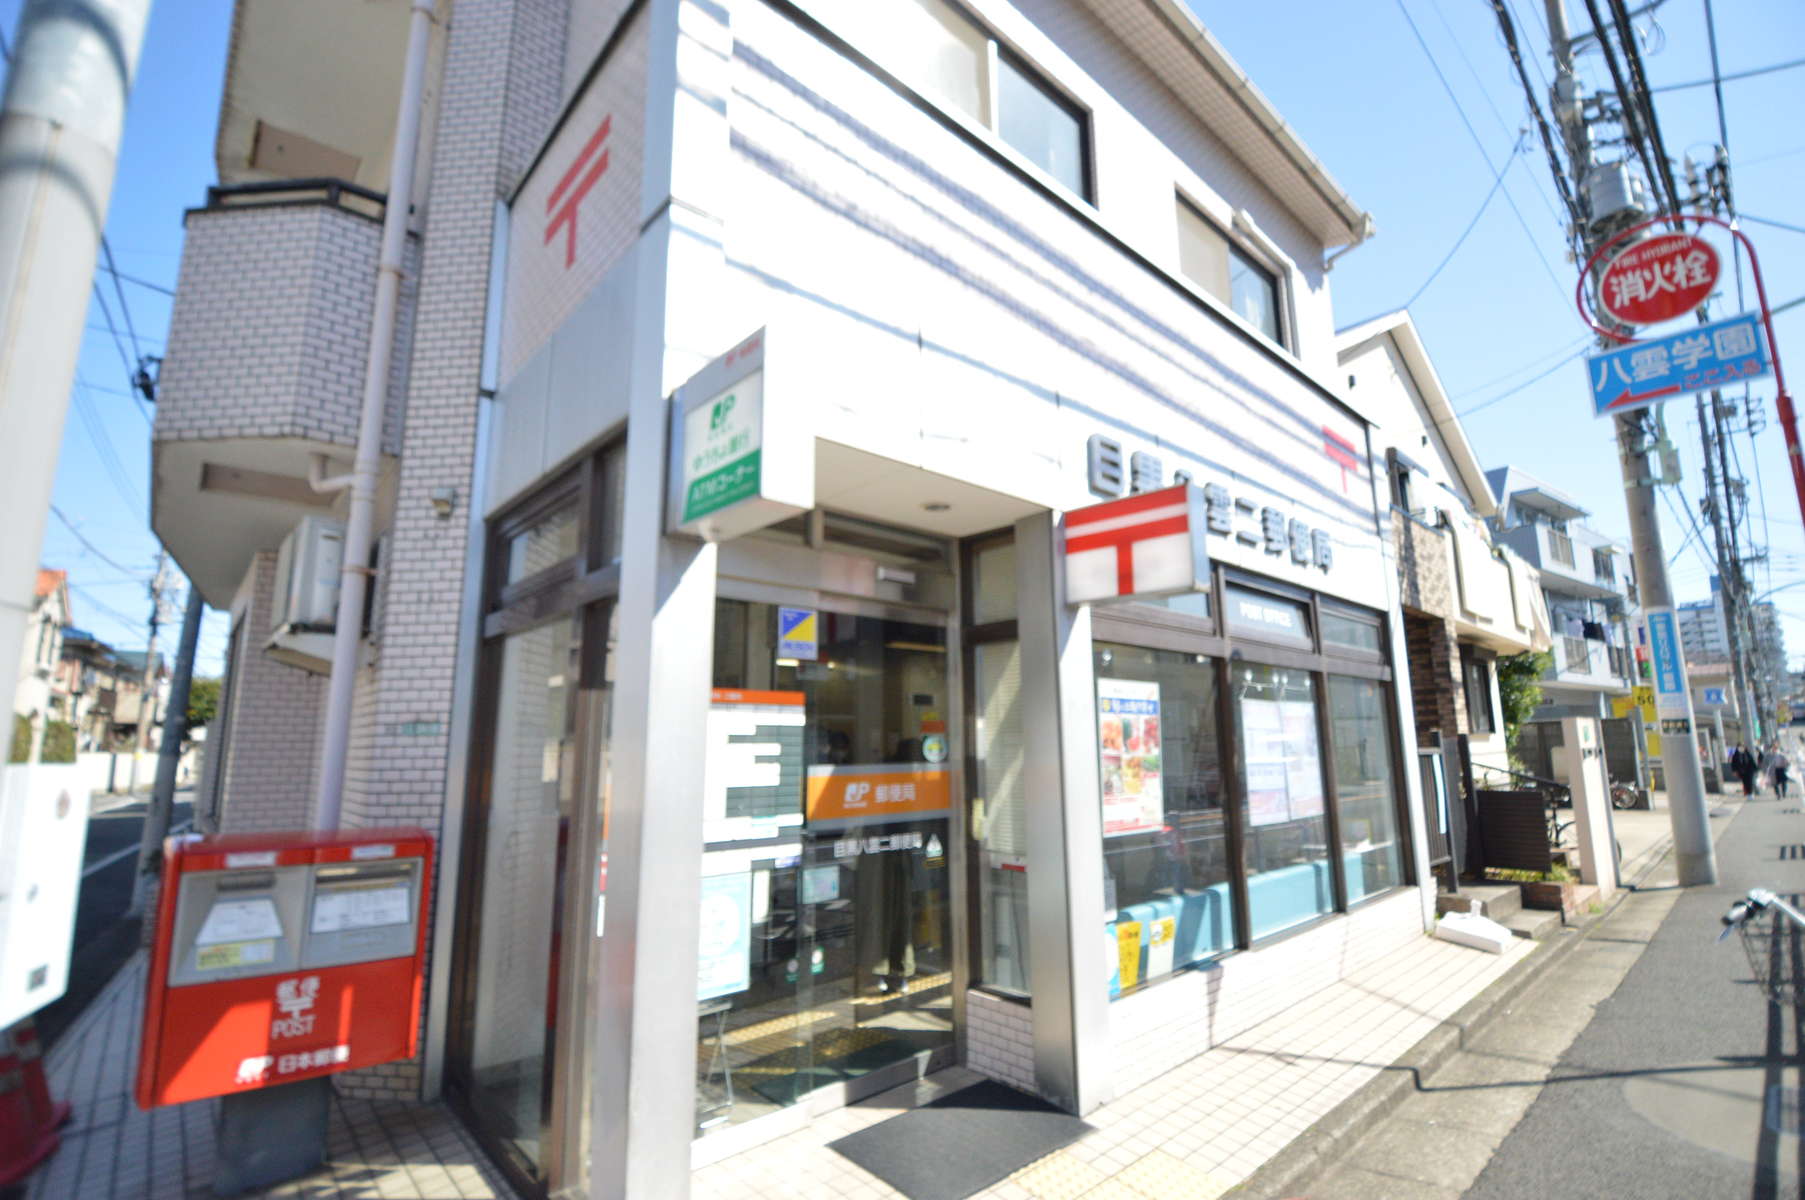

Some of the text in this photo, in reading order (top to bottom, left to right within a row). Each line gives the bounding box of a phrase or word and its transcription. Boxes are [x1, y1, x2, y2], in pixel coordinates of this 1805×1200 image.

[1609, 250, 1713, 310] 消火栓
[1595, 320, 1759, 393] 八雲学園
[271, 1014, 317, 1040] POST
